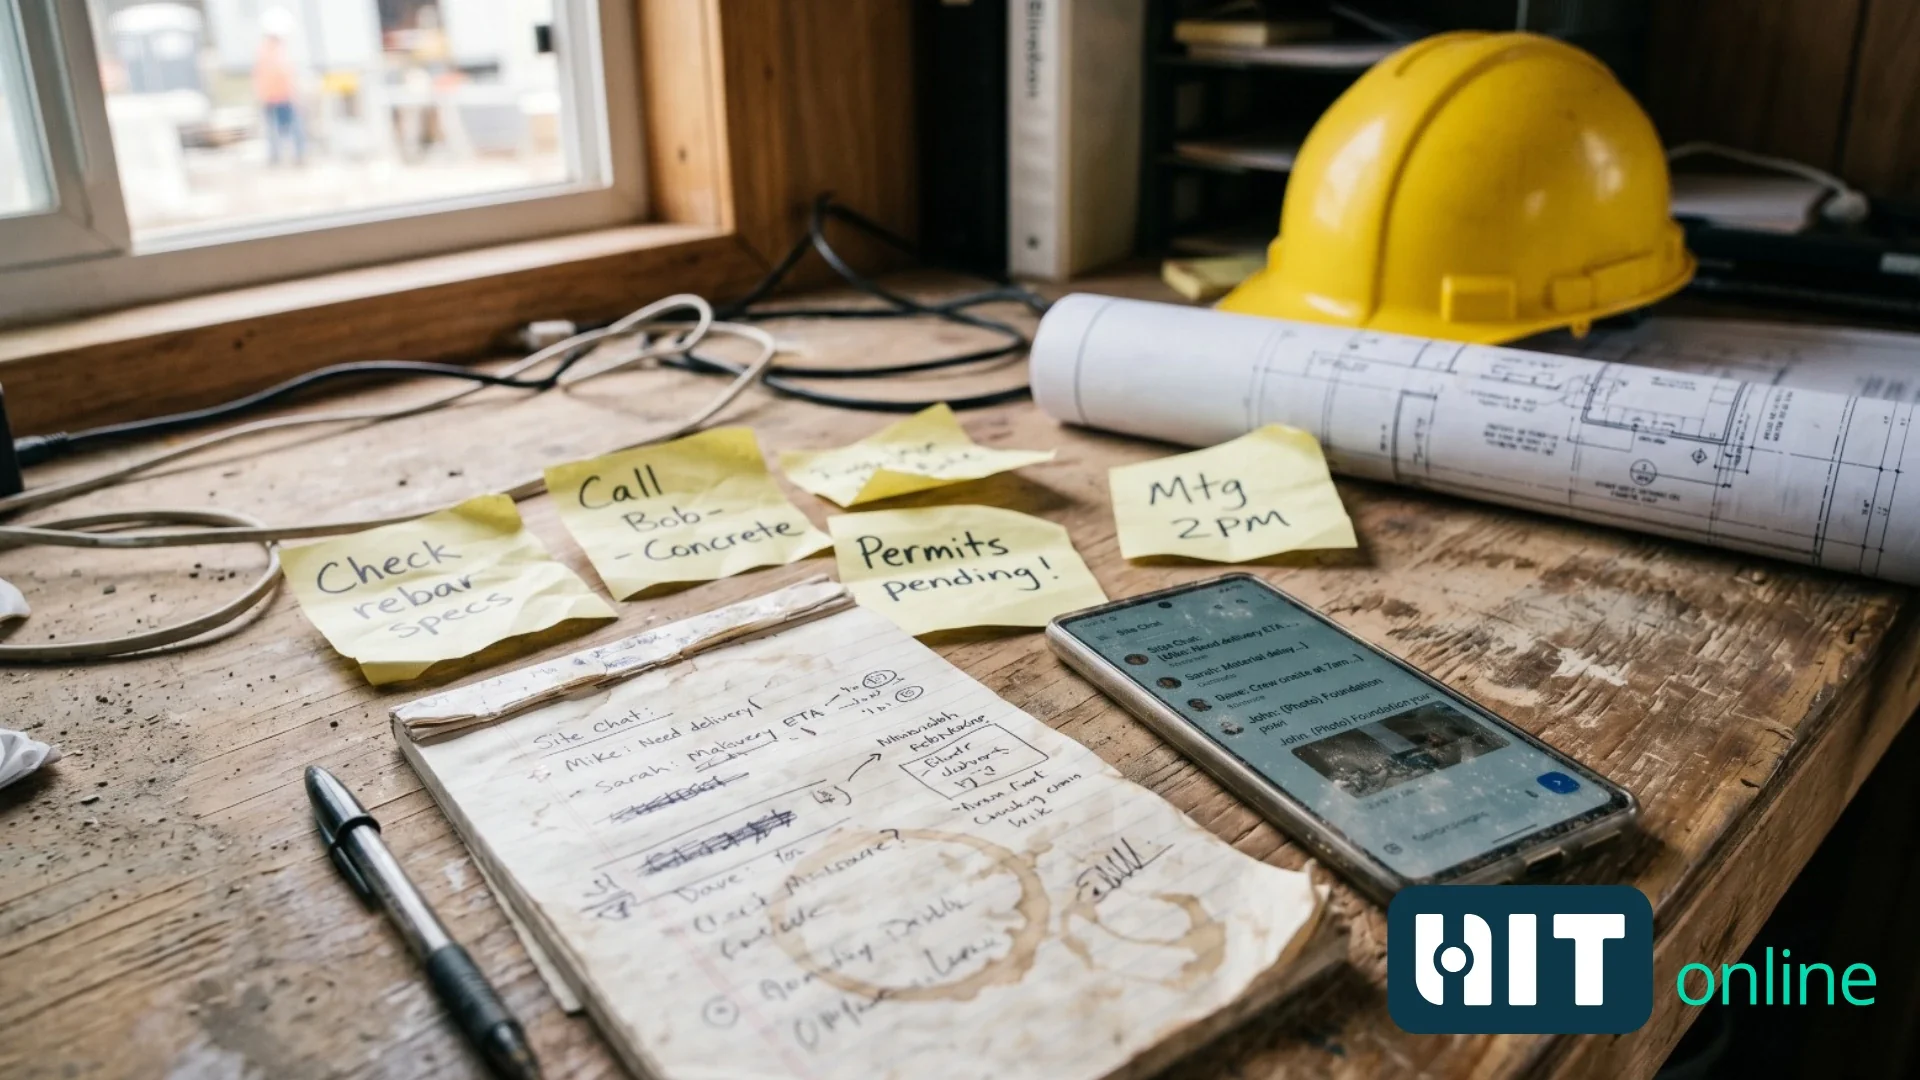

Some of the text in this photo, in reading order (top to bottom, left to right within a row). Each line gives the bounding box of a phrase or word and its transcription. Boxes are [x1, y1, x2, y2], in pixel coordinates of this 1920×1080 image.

[577, 464, 663, 510] Call
[1149, 472, 1248, 511] Mtg
[631, 517, 805, 562] Concrete
[856, 531, 1010, 570] Permits
[317, 539, 463, 595] Check
[882, 556, 1059, 602] pending!
[352, 572, 477, 620] rebar
[387, 590, 515, 640] specs
[1248, 678, 1278, 694] Crew
[532, 729, 584, 751] Site
[782, 708, 825, 729] ETA
[564, 745, 632, 774] Mike:
[638, 727, 682, 749] Need
